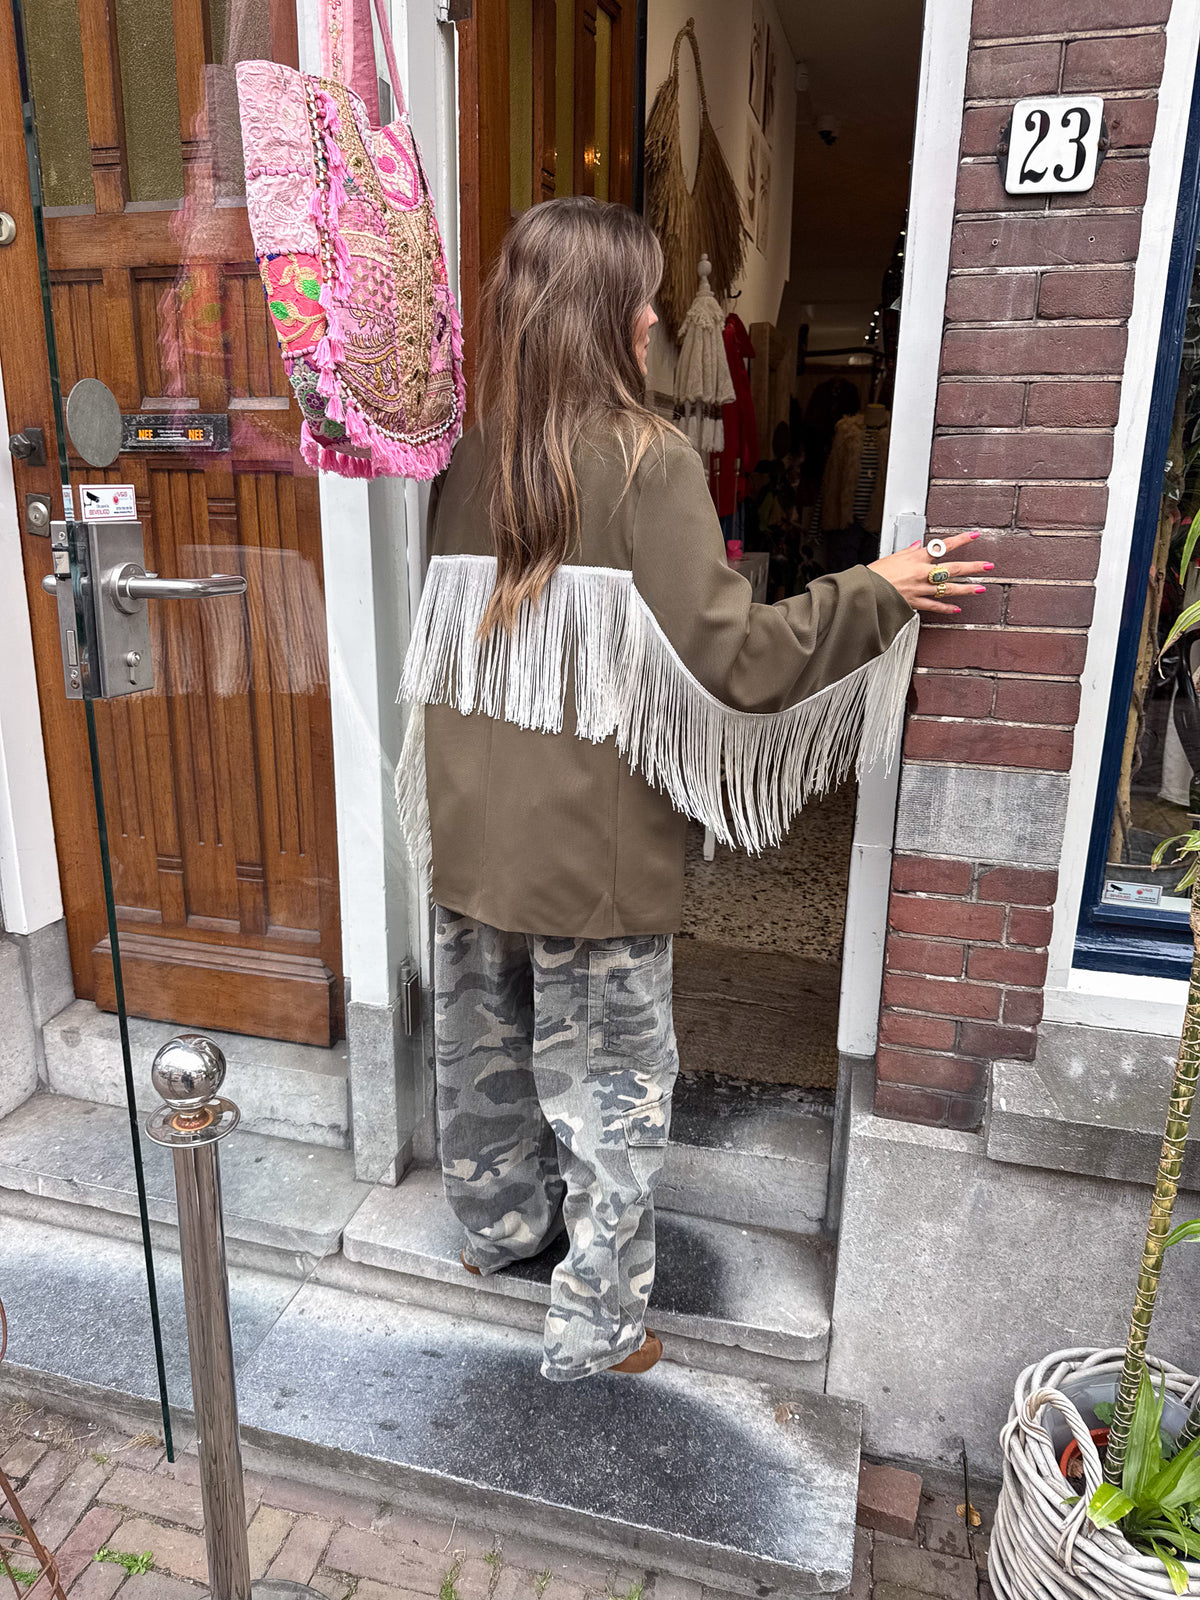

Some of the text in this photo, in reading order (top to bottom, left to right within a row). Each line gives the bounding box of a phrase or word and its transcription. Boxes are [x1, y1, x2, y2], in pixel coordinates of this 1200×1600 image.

[1019, 107, 1091, 185] 23
[138, 429, 153, 440] NEE
[188, 429, 204, 441] NEE
